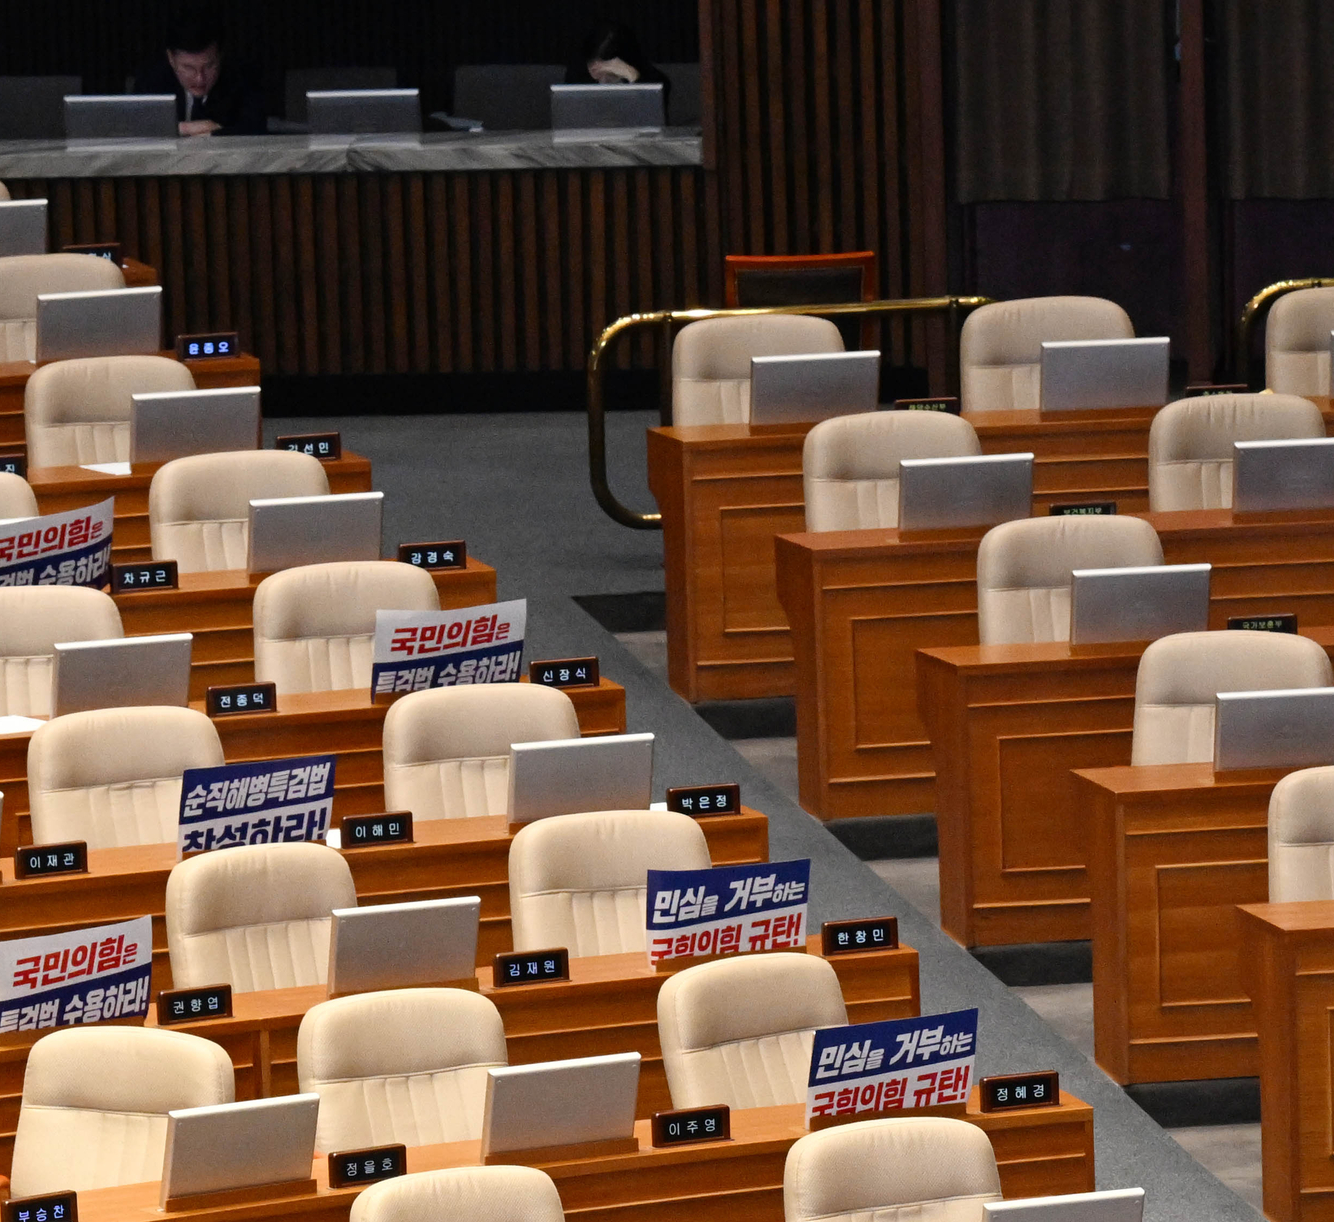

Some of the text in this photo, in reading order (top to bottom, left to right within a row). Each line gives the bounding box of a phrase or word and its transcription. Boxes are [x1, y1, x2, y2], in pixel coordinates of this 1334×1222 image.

[411, 551, 454, 564] 강경숙
[124, 570, 166, 584] 차규근
[391, 614, 510, 655] 국민의힘은
[437, 650, 521, 687] 수용하라!
[543, 667, 586, 682] 신장식
[220, 692, 264, 708] 전종덕
[183, 762, 331, 817] 순직해병특검법
[682, 795, 727, 809] 박은정
[356, 823, 400, 838] 이해민
[30, 852, 74, 869] 이재관
[653, 874, 805, 924] 민심을 거부하는
[749, 912, 802, 952] 규탄!
[838, 928, 884, 945] 한창민
[12, 934, 138, 990] 국민의힘은
[509, 960, 555, 977] 김재원
[63, 975, 149, 1025] 수용하라!
[173, 996, 219, 1014] 권향엽
[816, 1025, 973, 1079] 민심을 거부하는
[913, 1065, 970, 1107] 규탄!
[997, 1084, 1045, 1101] 정혜경
[669, 1118, 716, 1136] 이주영
[346, 1158, 393, 1176] 정을호
[18, 1205, 64, 1222] 부승찬
